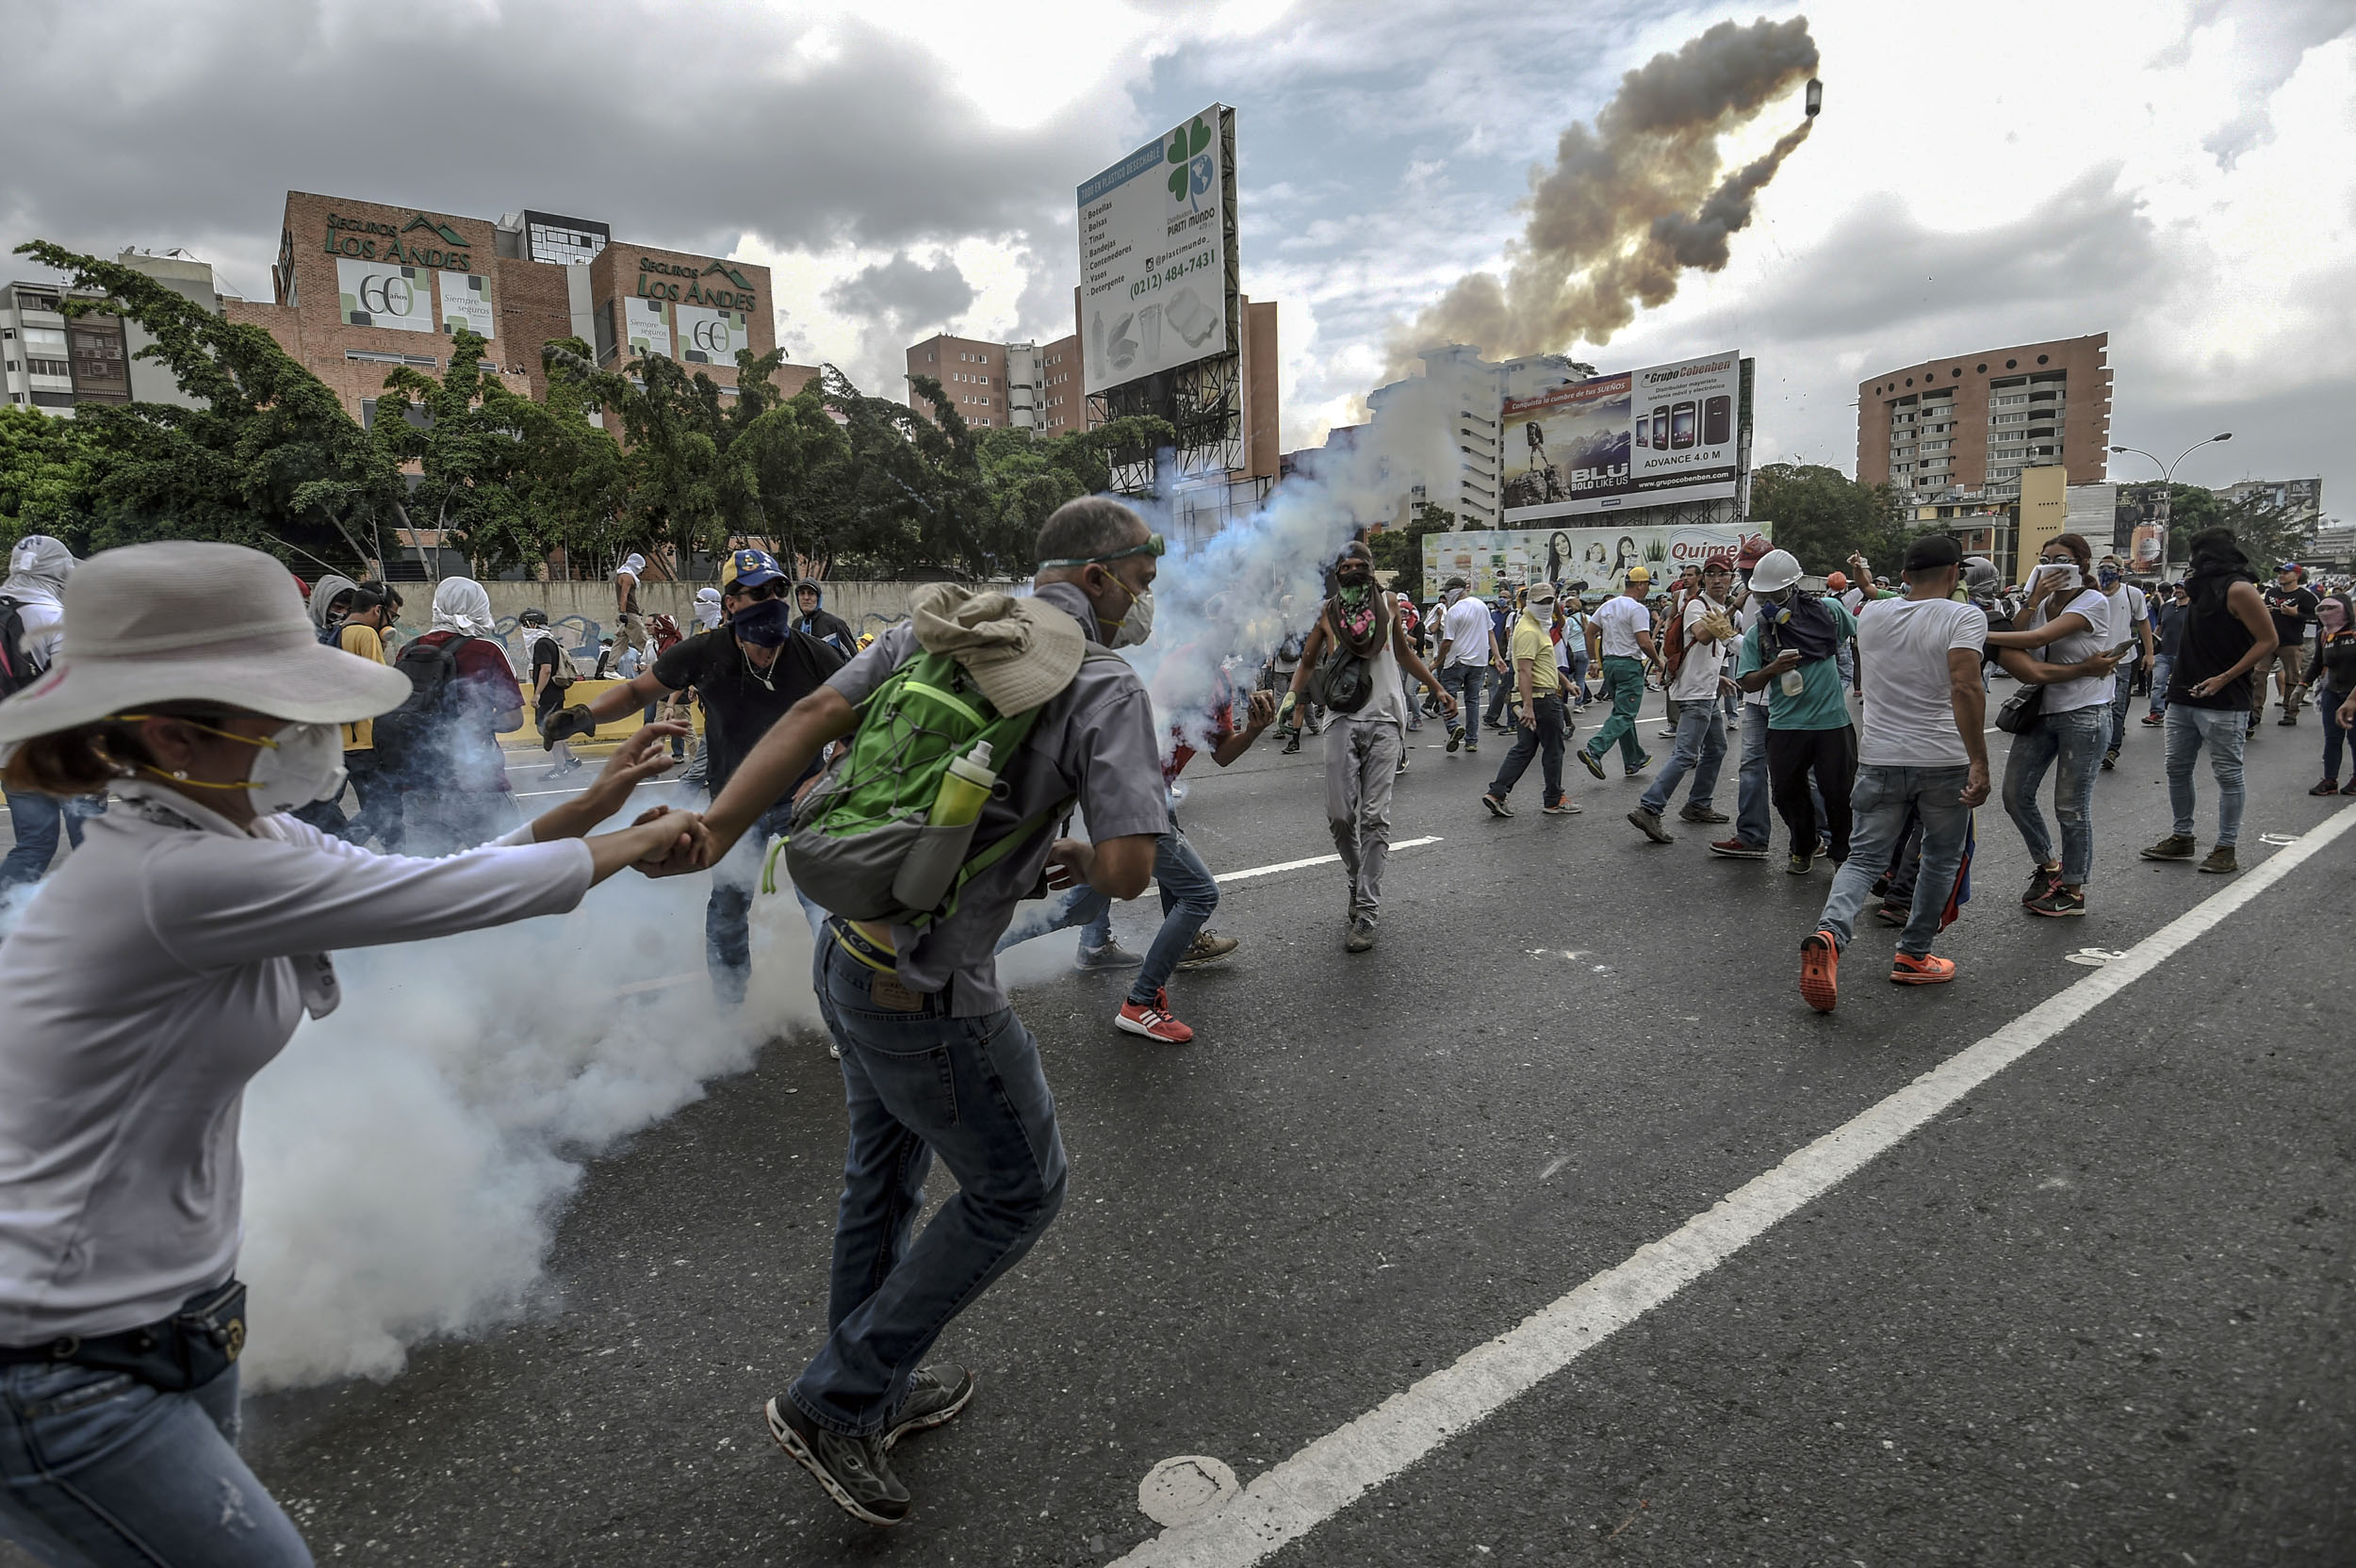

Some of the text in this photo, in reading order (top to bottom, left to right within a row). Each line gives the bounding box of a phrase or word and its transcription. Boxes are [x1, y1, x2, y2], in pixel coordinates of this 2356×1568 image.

[1126, 146, 1160, 175] DESECHABLE
[1088, 202, 1113, 220] Botellas
[327, 213, 398, 237] SEGUROS
[1088, 217, 1107, 233] Bolsas
[1168, 207, 1215, 237] PLASTI MUNDO
[1088, 232, 1105, 245] Tinas
[325, 227, 471, 271] LOS ANDES
[1089, 239, 1117, 258] Bandejas
[1089, 244, 1132, 270] Contenedores
[639, 257, 699, 279] SEGUROS
[1090, 270, 1107, 284] Vasos
[1130, 249, 1215, 302] (0212) 484-7431
[638, 273, 757, 312] LOS ANDES
[1090, 275, 1125, 296] Detergente
[444, 294, 480, 305] Siempre
[457, 304, 490, 315] seguros
[630, 319, 659, 331] Siempre
[641, 329, 667, 337] seguros
[1656, 378, 1717, 393] Distribuidor mayorista
[1512, 398, 1543, 410] Conquista
[1550, 393, 1575, 402] cumbre
[1596, 382, 1626, 394] SUEÑOS
[1644, 450, 1721, 468] ADVANCE 4.0 M
[1571, 476, 1628, 492] BOLD LIKE US
[1638, 472, 1729, 488] www.grupocobenben.com
